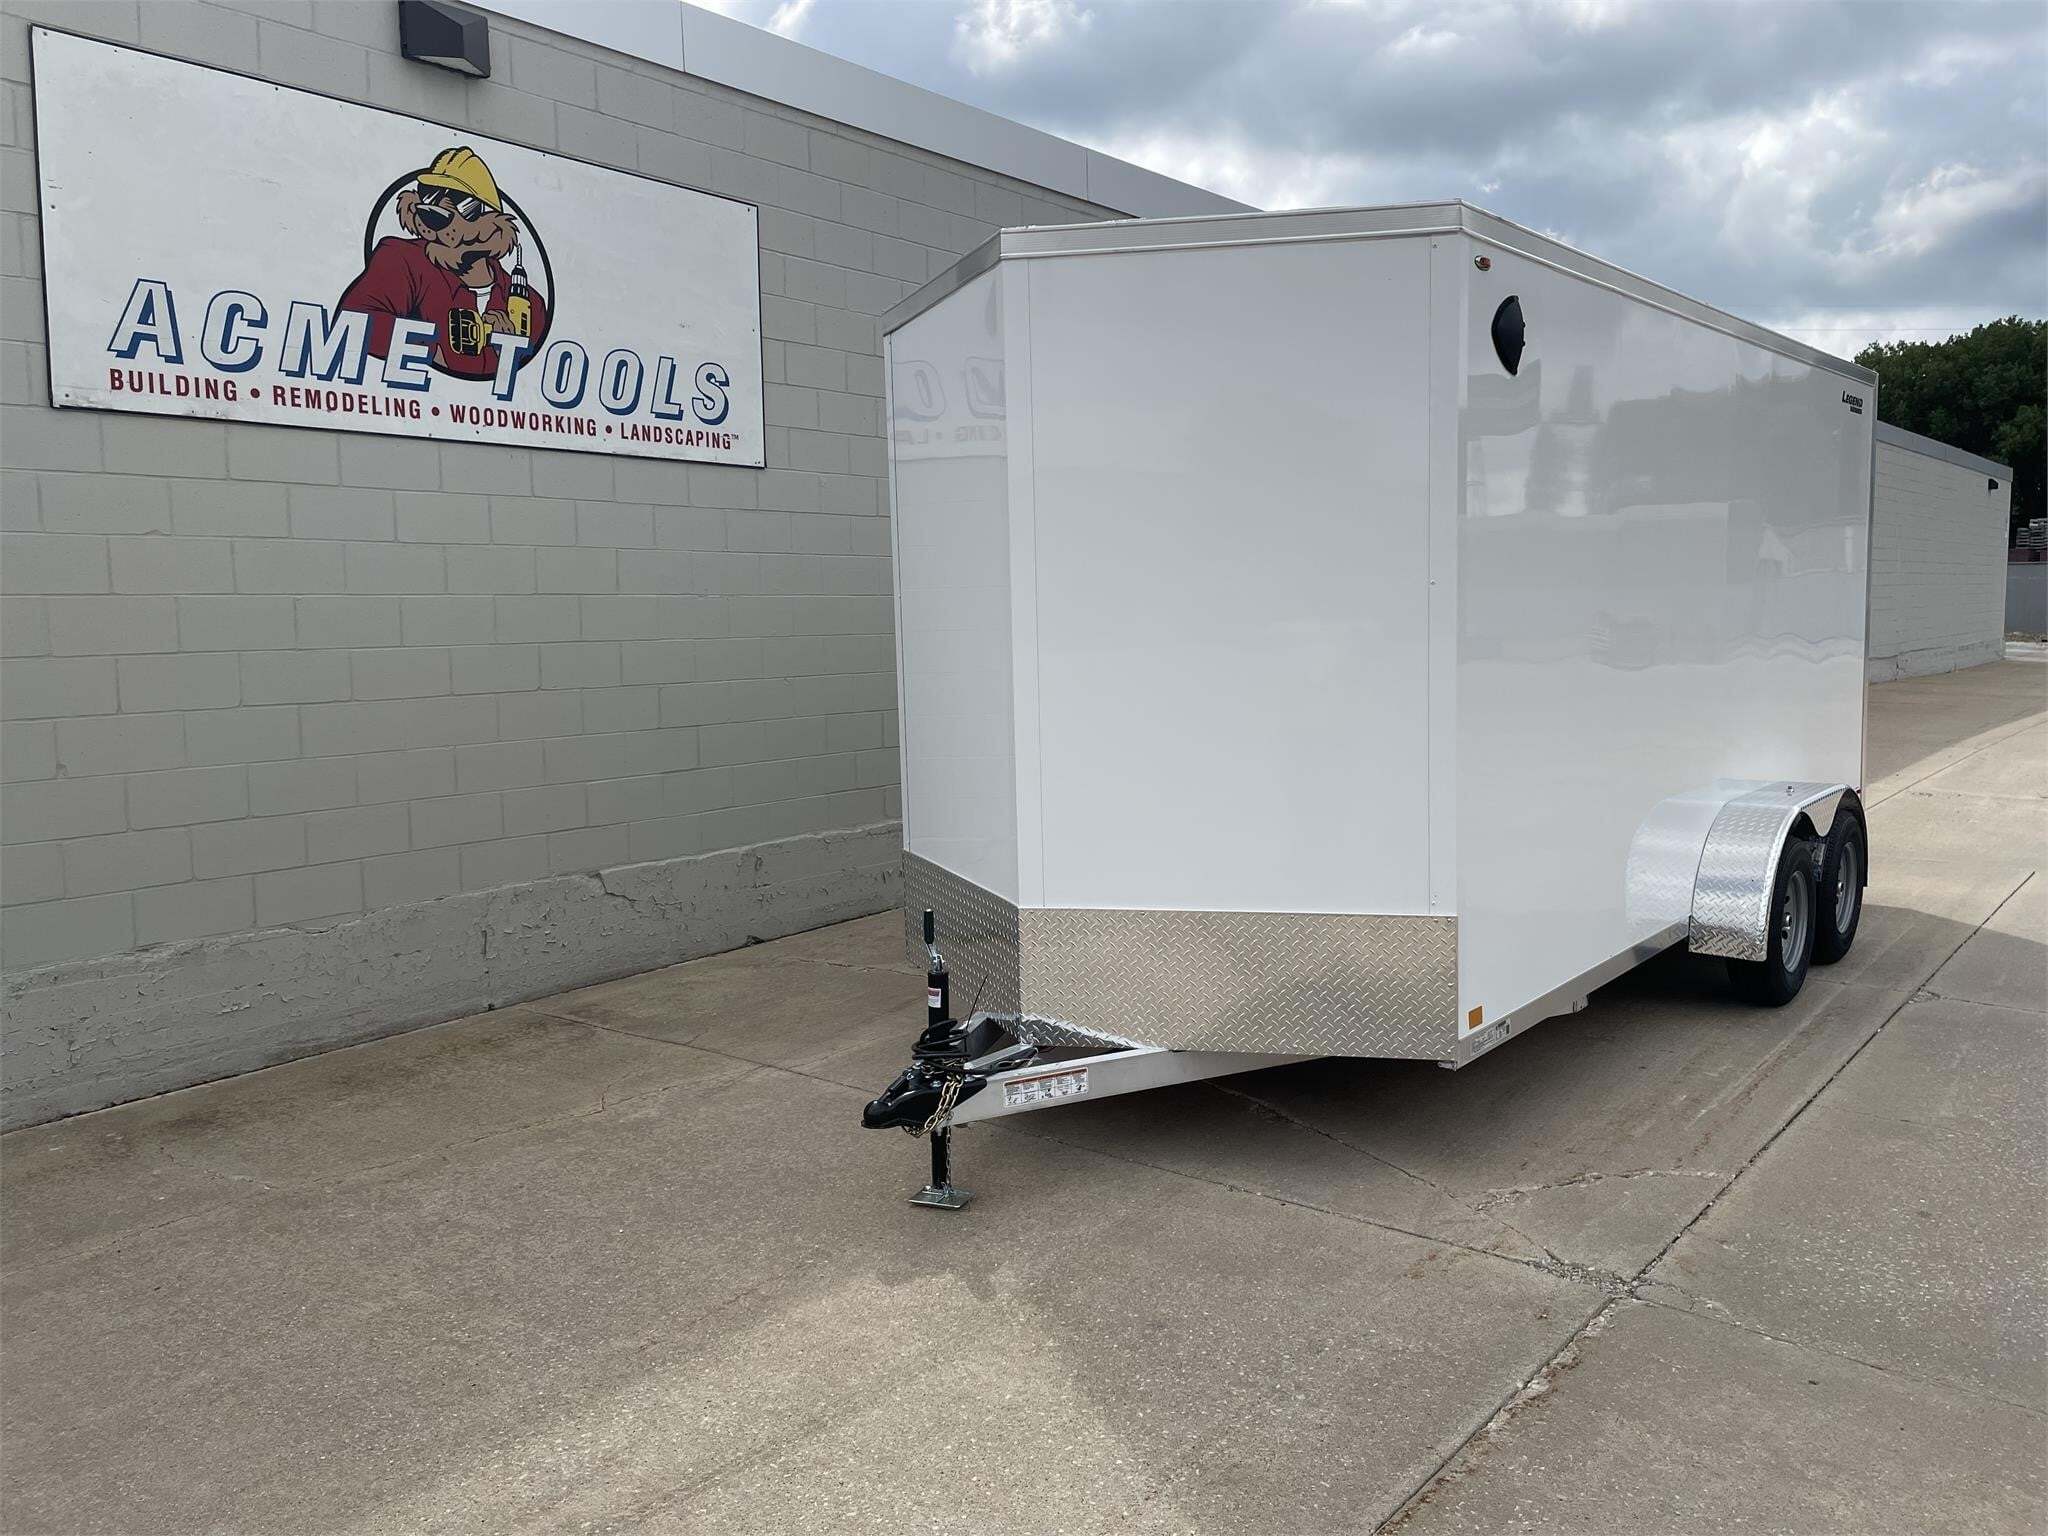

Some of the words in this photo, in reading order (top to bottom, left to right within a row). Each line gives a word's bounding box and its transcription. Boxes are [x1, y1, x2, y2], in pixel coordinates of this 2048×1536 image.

[107, 278, 439, 392] ACME
[489, 331, 730, 426] TOOLS
[109, 368, 238, 402] BUILDING
[272, 385, 421, 419] REMODELING
[449, 404, 597, 437] WOODWORKING
